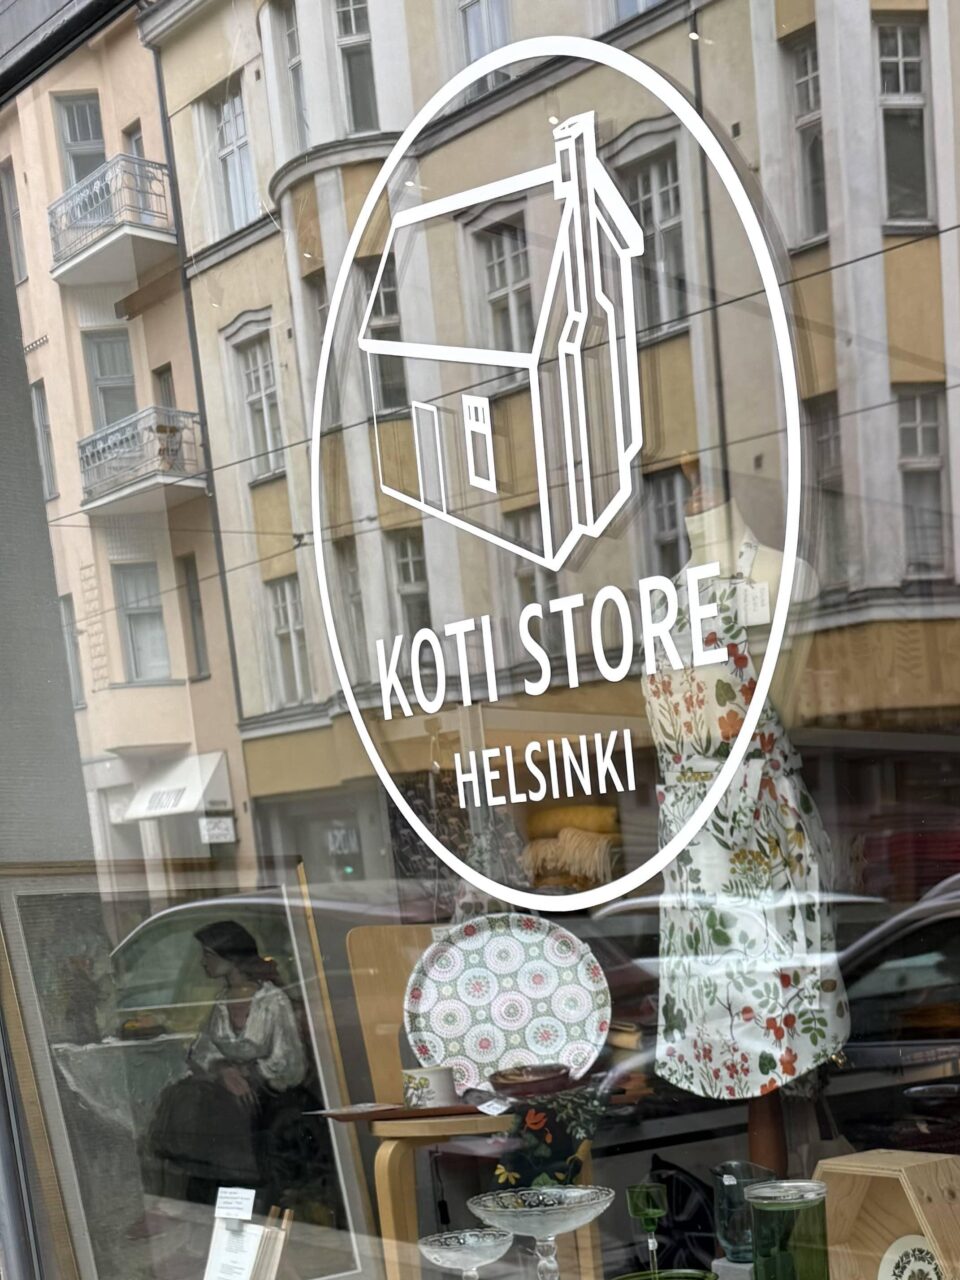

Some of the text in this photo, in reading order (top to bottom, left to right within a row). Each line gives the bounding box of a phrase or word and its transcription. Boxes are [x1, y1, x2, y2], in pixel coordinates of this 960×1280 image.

[376, 561, 729, 720] KOTI STORE
[454, 729, 636, 809] HELSINKI
